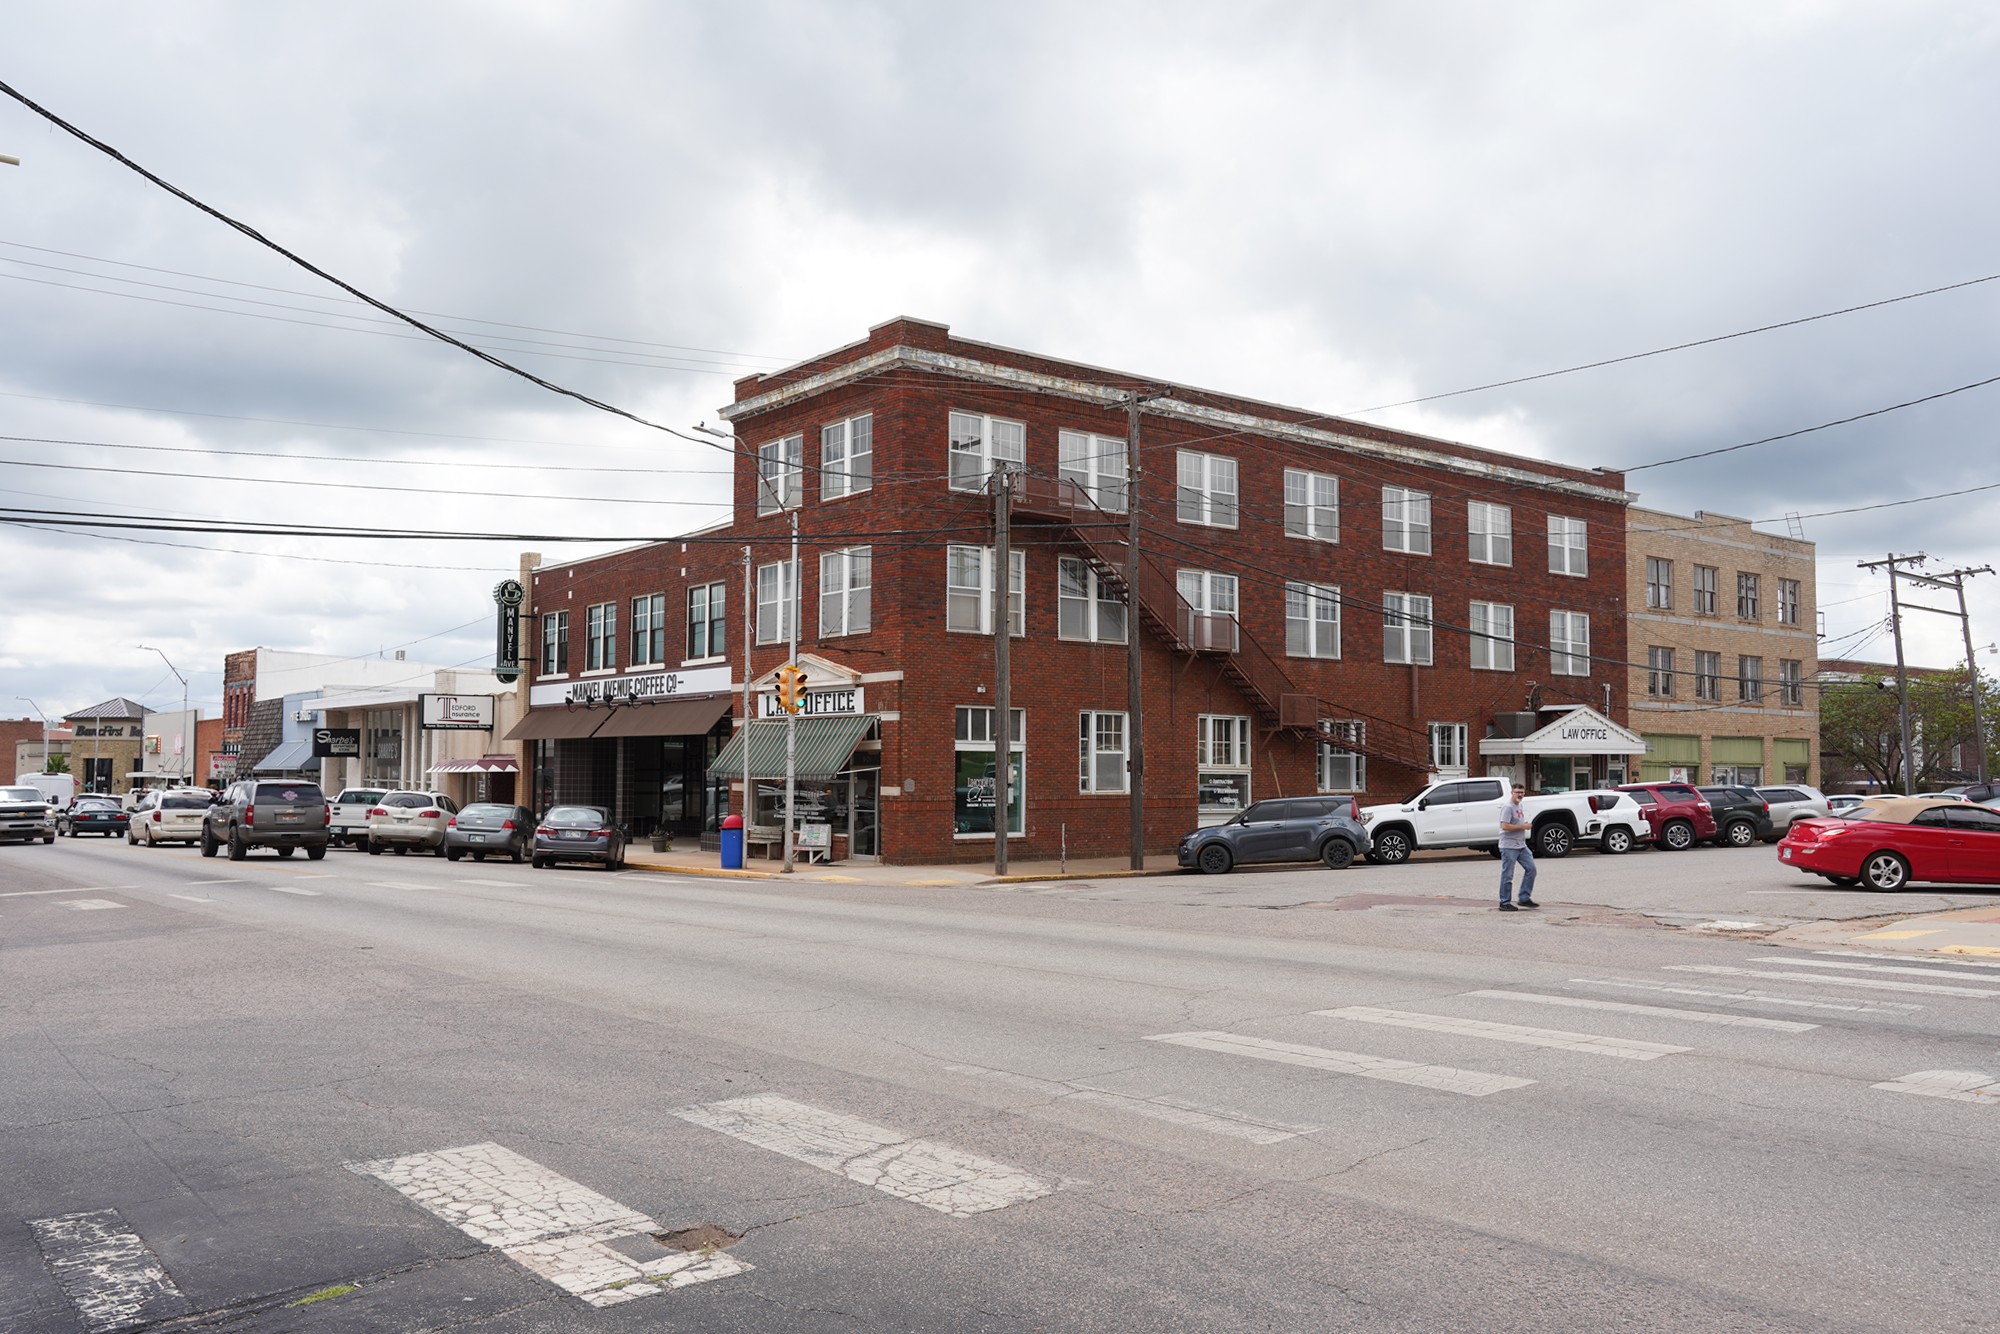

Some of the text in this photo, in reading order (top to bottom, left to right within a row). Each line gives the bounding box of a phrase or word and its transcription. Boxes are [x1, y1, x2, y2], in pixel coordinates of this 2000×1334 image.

[572, 681, 601, 701] MANVEL
[603, 678, 633, 700] AVENUE
[634, 675, 665, 696] COFFEE
[804, 689, 856, 715] OFFICE
[1562, 729, 1607, 740] LAW OFFICE
